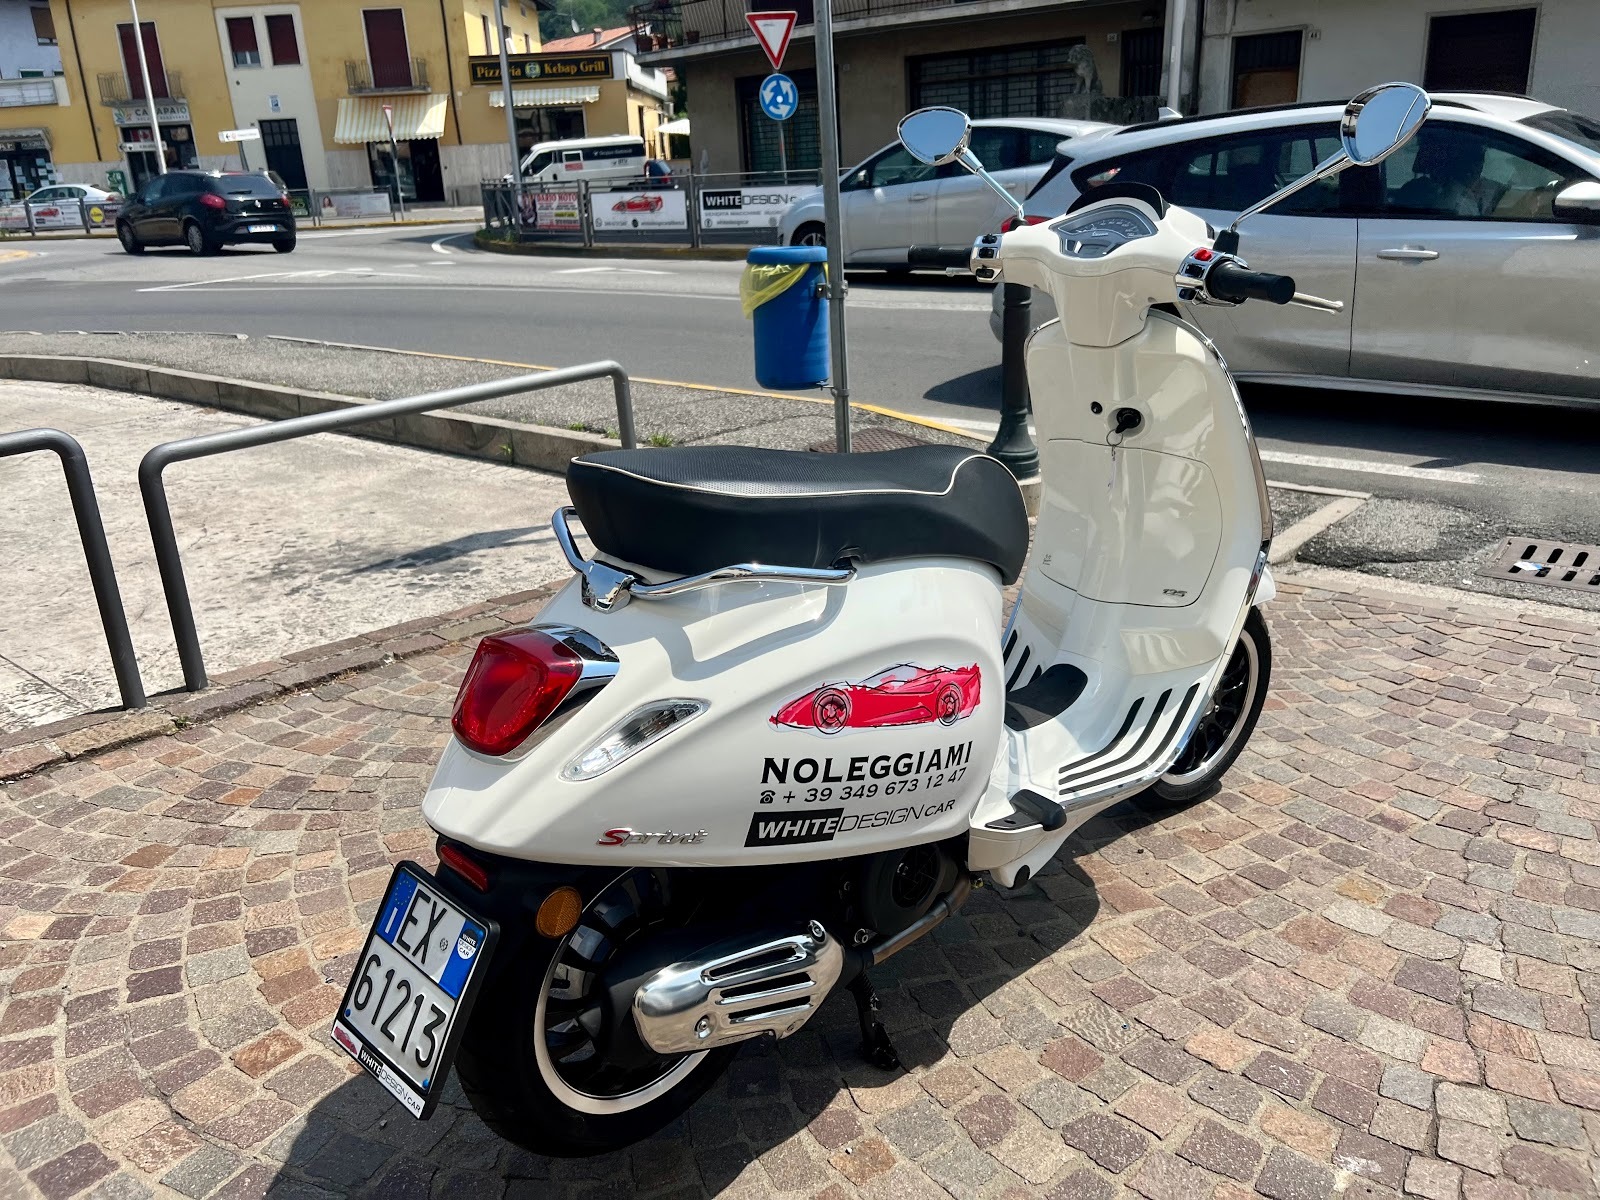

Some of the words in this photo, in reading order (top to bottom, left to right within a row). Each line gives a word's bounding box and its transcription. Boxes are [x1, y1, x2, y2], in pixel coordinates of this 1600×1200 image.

[476, 66, 522, 78] Pizzia
[544, 63, 578, 75] Kebap
[580, 61, 606, 73] Grill
[135, 106, 187, 116] CAAPAIO
[760, 740, 973, 785] NOLEGGIAMI
[804, 787, 833, 803] 39
[839, 783, 878, 800] 349
[885, 778, 919, 795] 673
[926, 773, 943, 790] 12
[948, 767, 966, 784] 47
[924, 799, 956, 818] CAR
[596, 827, 708, 847] Sprint
[396, 888, 448, 965] EX
[459, 947, 470, 957] CAR
[354, 954, 448, 1069] 61213
[407, 1096, 421, 1113] CAR
